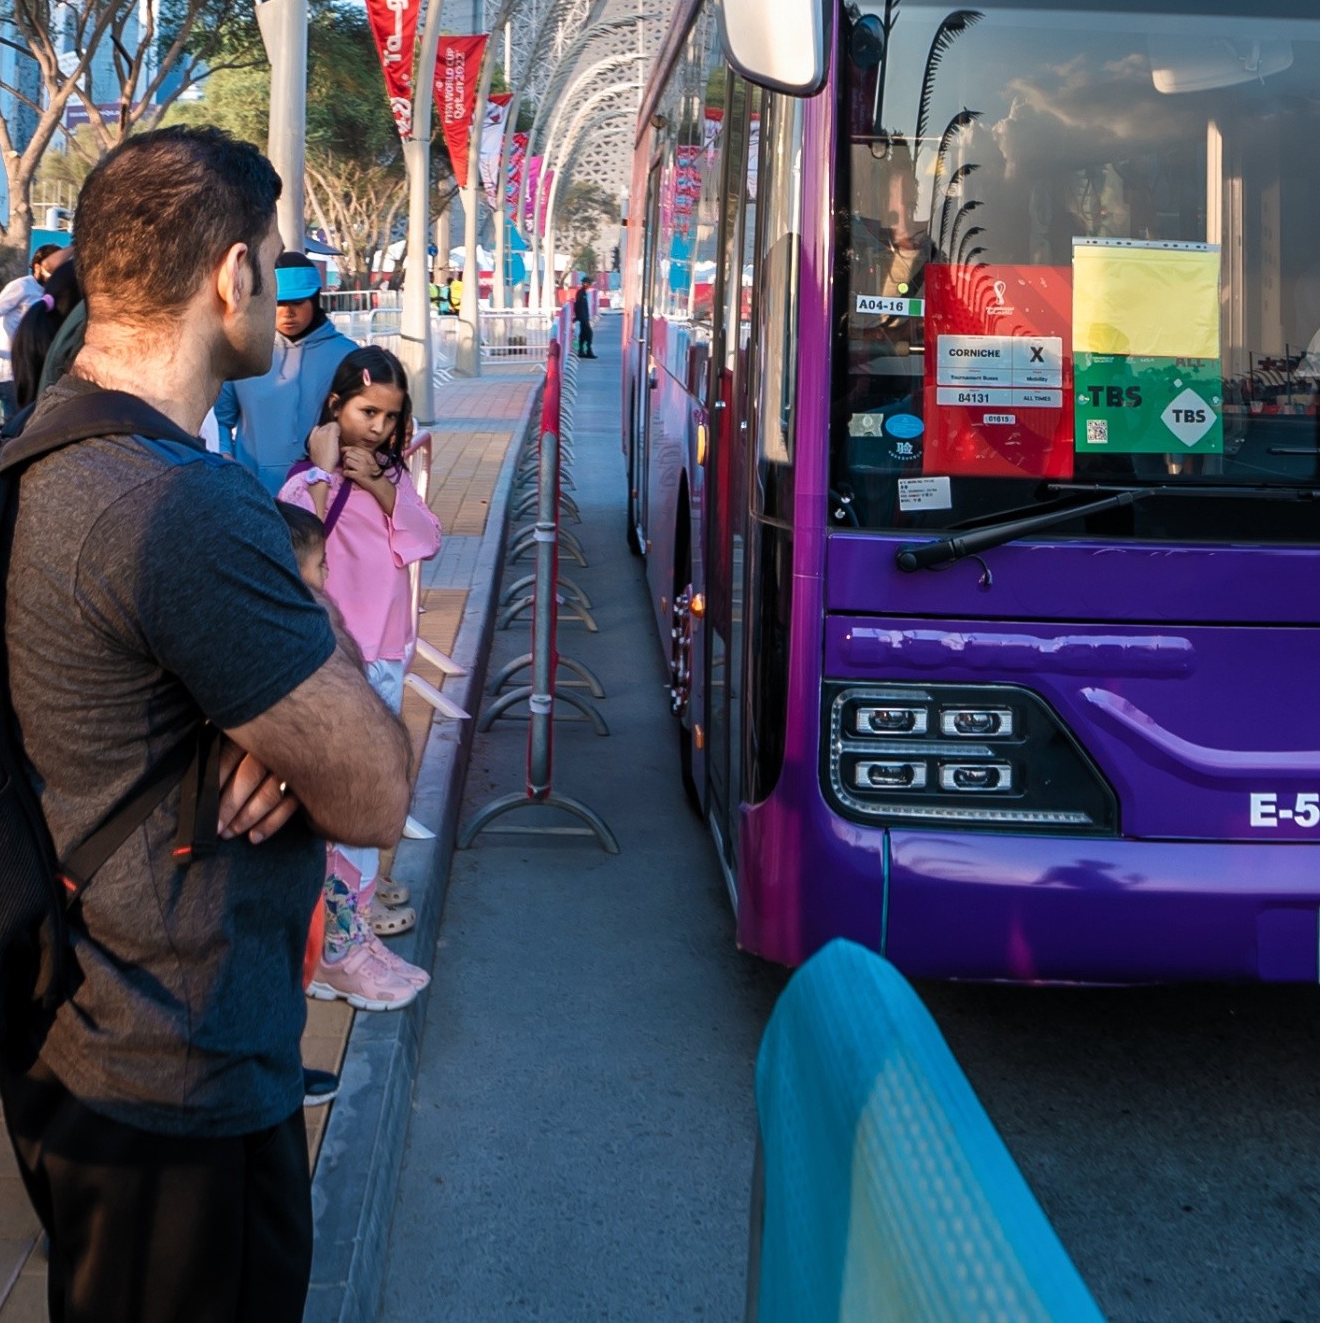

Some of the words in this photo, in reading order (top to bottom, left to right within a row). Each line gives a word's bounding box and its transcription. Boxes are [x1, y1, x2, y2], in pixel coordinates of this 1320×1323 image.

[859, 299, 904, 311] A04-16
[949, 349, 1001, 358] CORNICHE
[1030, 347, 1044, 363] X
[958, 393, 989, 403] 84131
[1087, 386, 1142, 408] TBS
[1172, 409, 1206, 423] TBS
